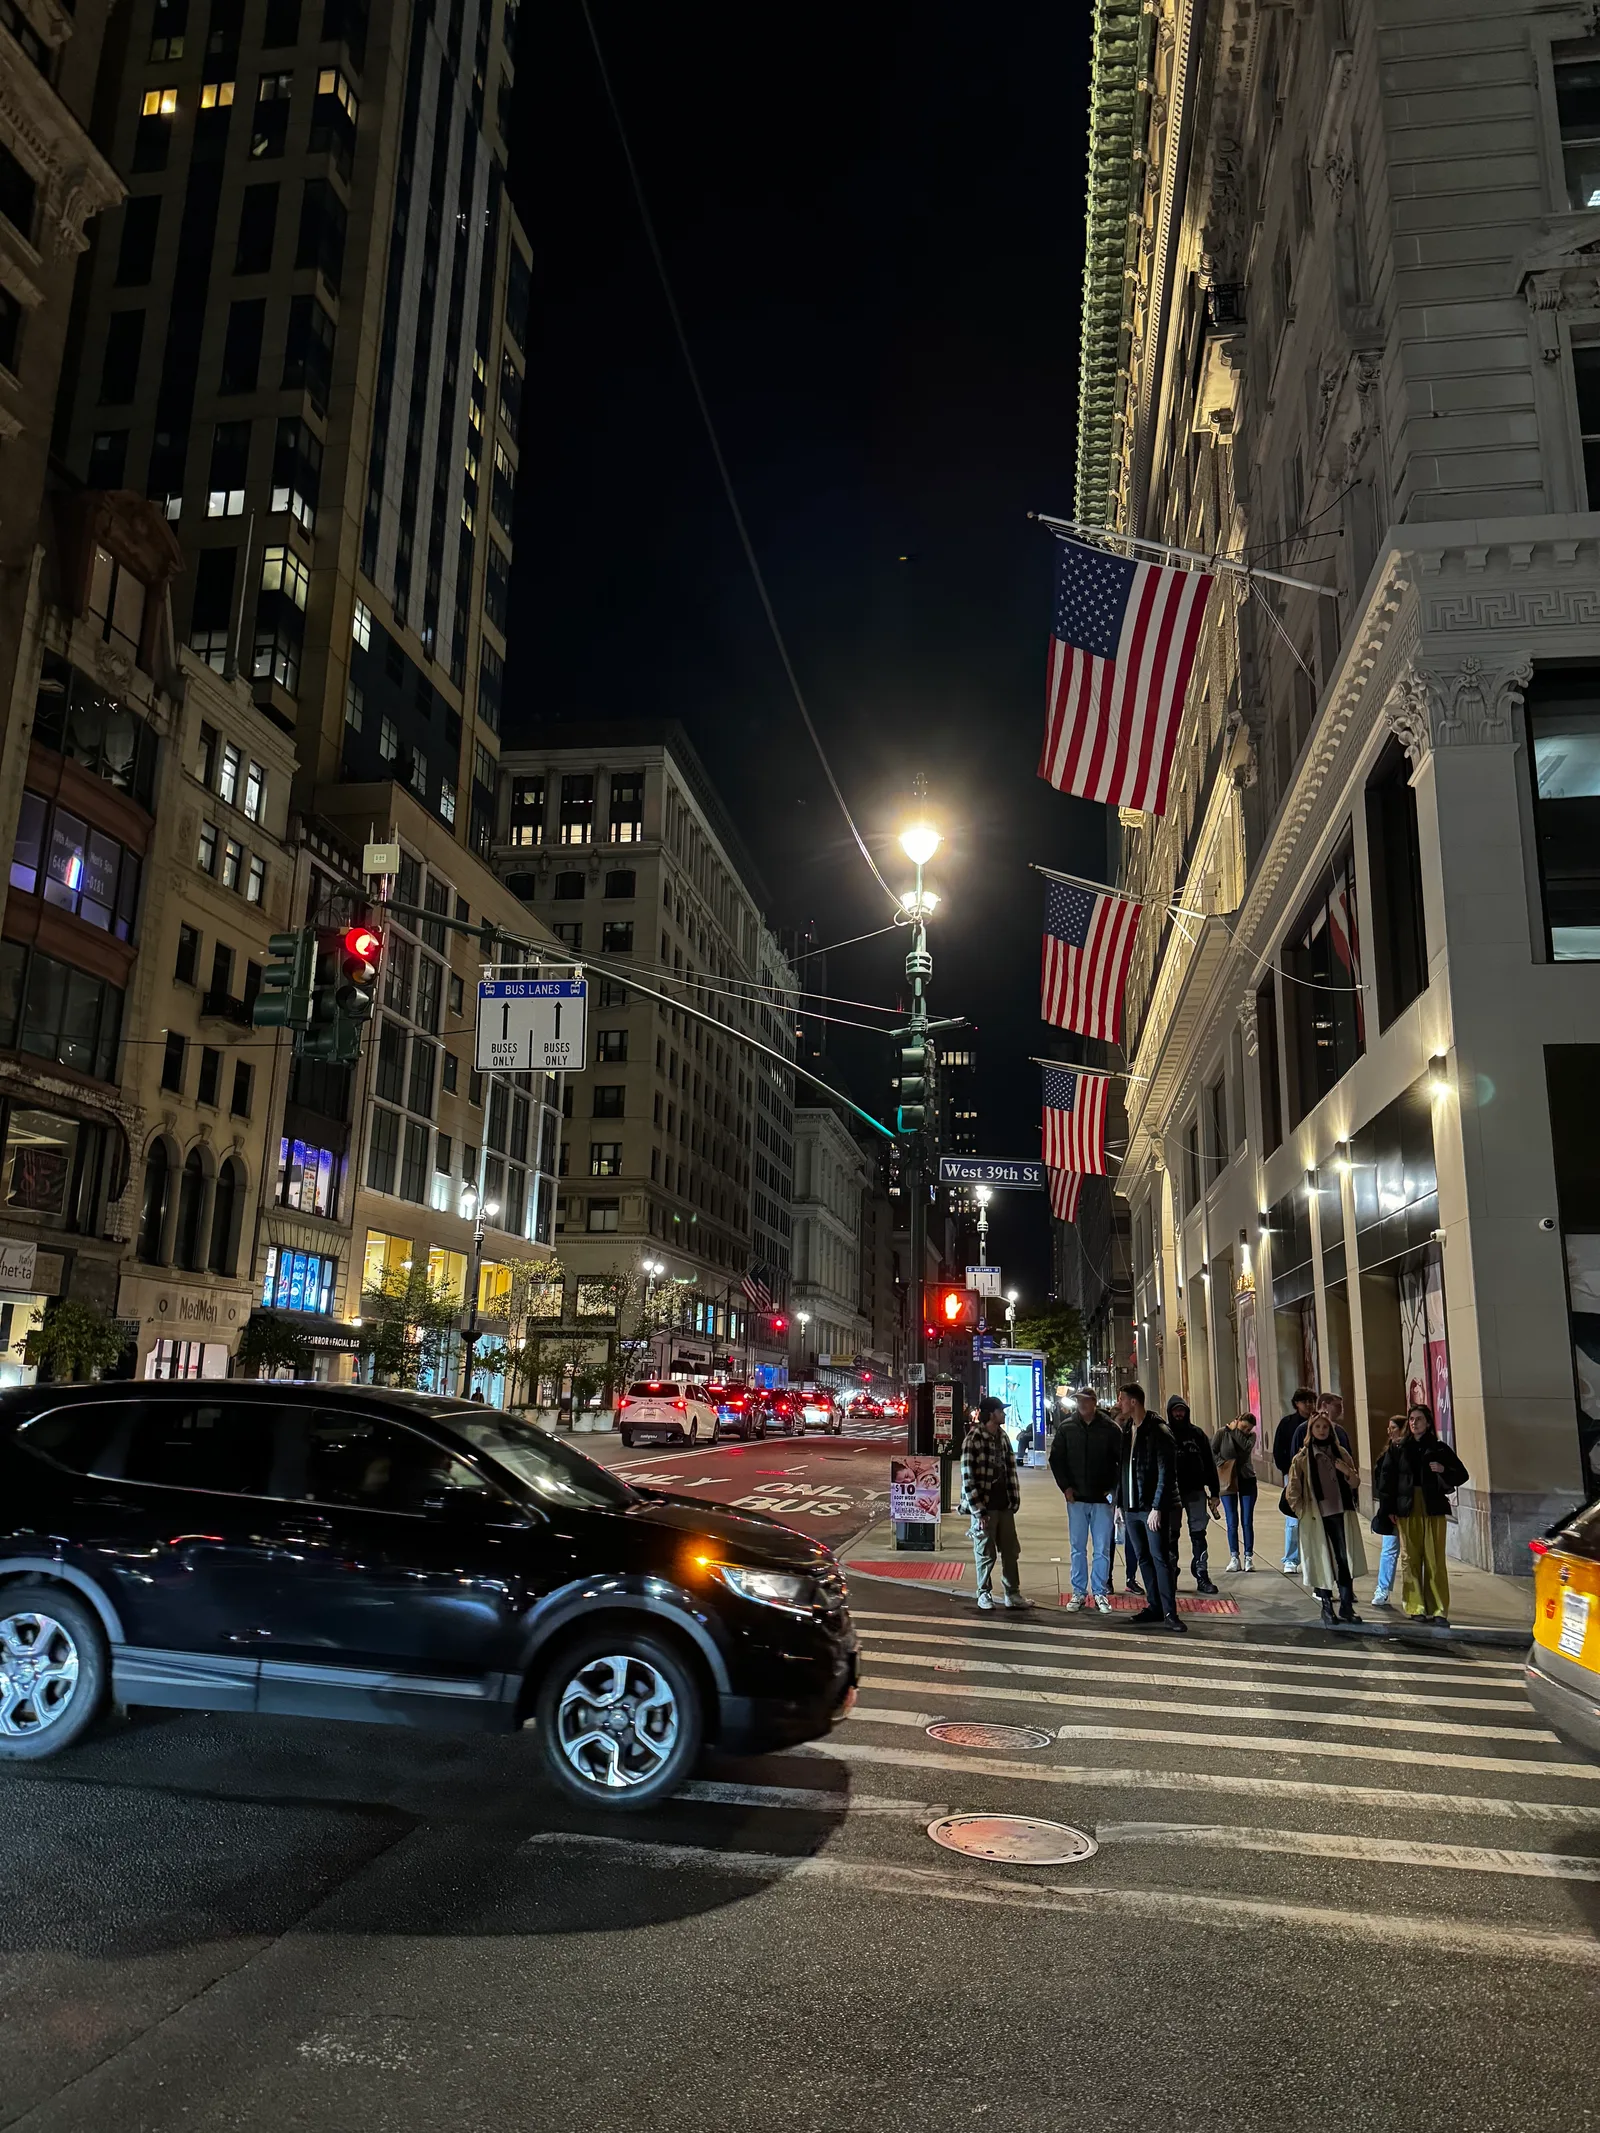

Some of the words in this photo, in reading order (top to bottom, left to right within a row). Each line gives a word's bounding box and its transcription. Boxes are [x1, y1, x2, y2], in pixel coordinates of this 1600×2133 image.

[505, 984, 525, 995] BUS
[528, 984, 560, 995] LANES
[491, 1042, 518, 1054] BUSES
[543, 1042, 570, 1053] BUSES
[492, 1055, 516, 1067] ONLY
[545, 1055, 568, 1066] ONLY
[944, 1163, 983, 1178] West
[985, 1165, 1019, 1181] 39th
[1022, 1166, 1040, 1182] St
[180, 1297, 218, 1323] MedMen
[333, 1337, 350, 1348] FACIAL
[350, 1339, 360, 1348] BAR
[753, 1482, 891, 1500] ONLY
[895, 1484, 915, 1494] $10
[727, 1495, 851, 1517] BUS
